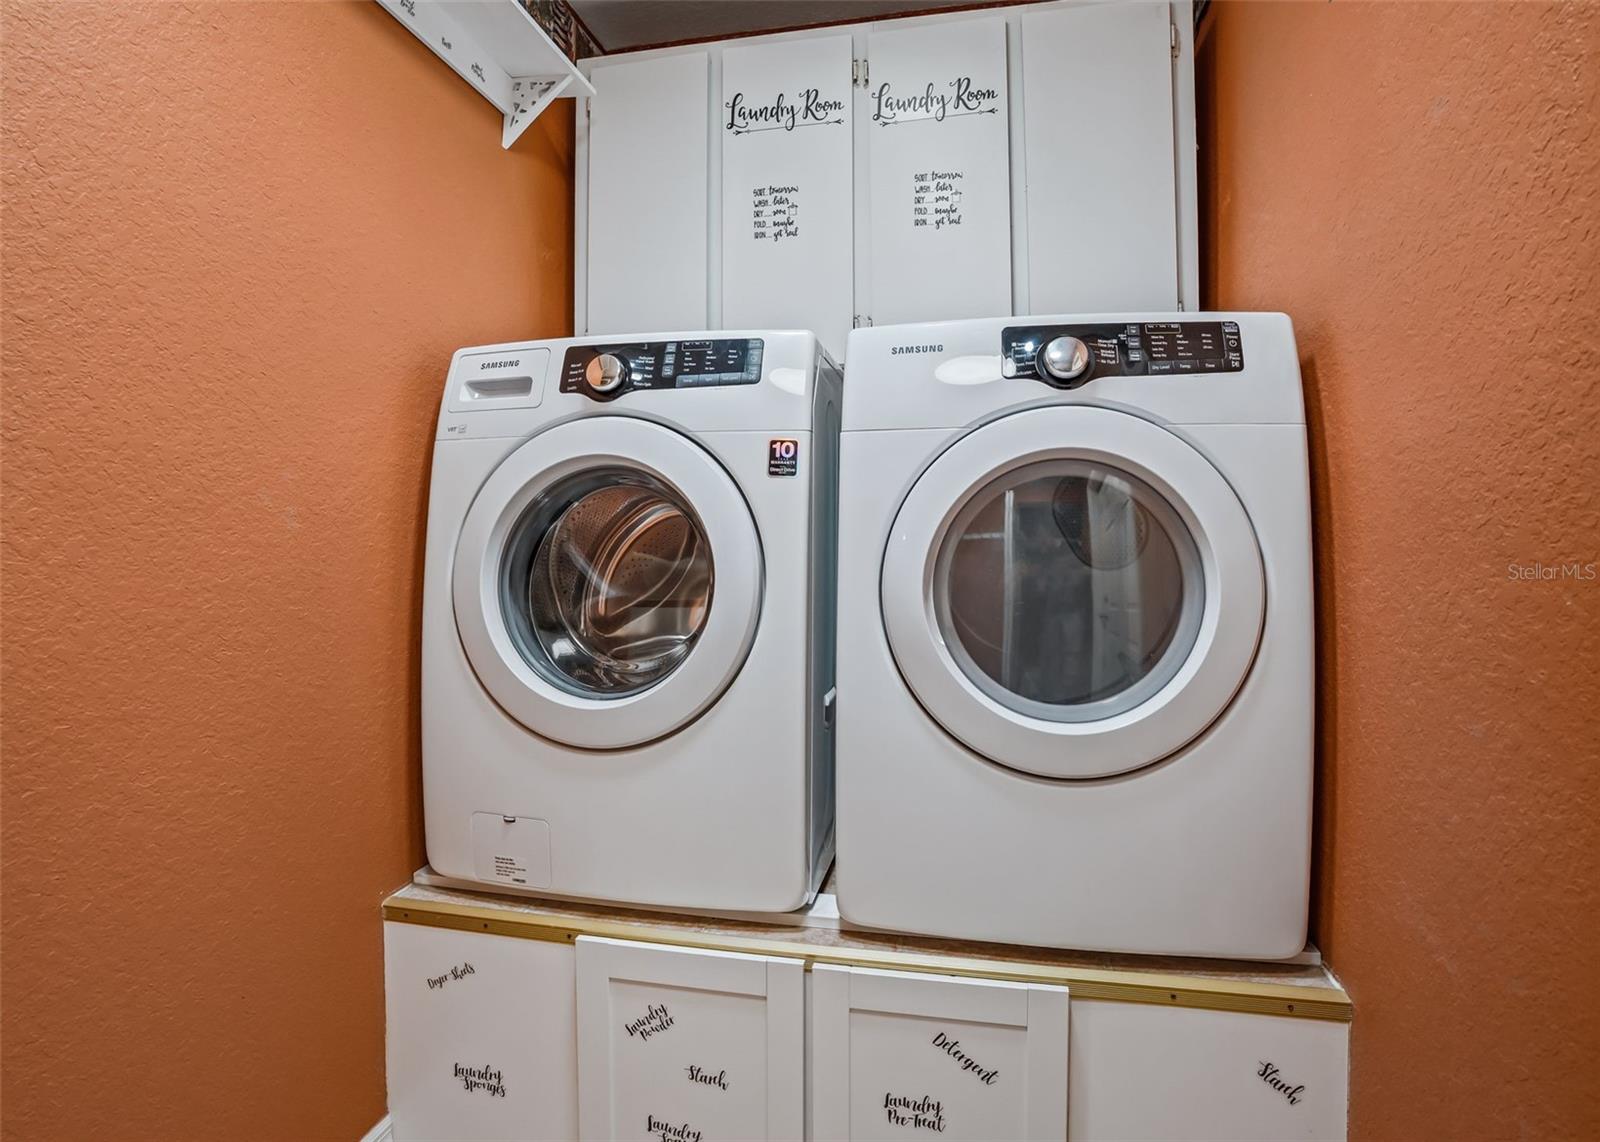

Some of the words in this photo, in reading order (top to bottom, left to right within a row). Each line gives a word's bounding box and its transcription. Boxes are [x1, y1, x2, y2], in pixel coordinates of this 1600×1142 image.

[726, 93, 800, 131] Laundry
[799, 89, 844, 121] Room
[872, 83, 950, 122] Laundry
[949, 77, 999, 110] Room
[891, 344, 944, 356] SAMSUNG
[480, 359, 520, 370] SAMSUNG
[772, 441, 795, 458] 10
[427, 974, 449, 989] Dryer
[625, 1003, 669, 1037] Laundry
[639, 1014, 675, 1042] Powder
[932, 1032, 999, 1085] Detergent
[454, 1062, 504, 1085] Laundry
[460, 1075, 506, 1098] Sponges
[684, 1064, 730, 1091] Starch
[1257, 1060, 1305, 1105] Starch
[884, 1092, 943, 1118] Laundry
[647, 1114, 703, 1142] Laundry
[888, 1108, 946, 1132] Pre-Treat
